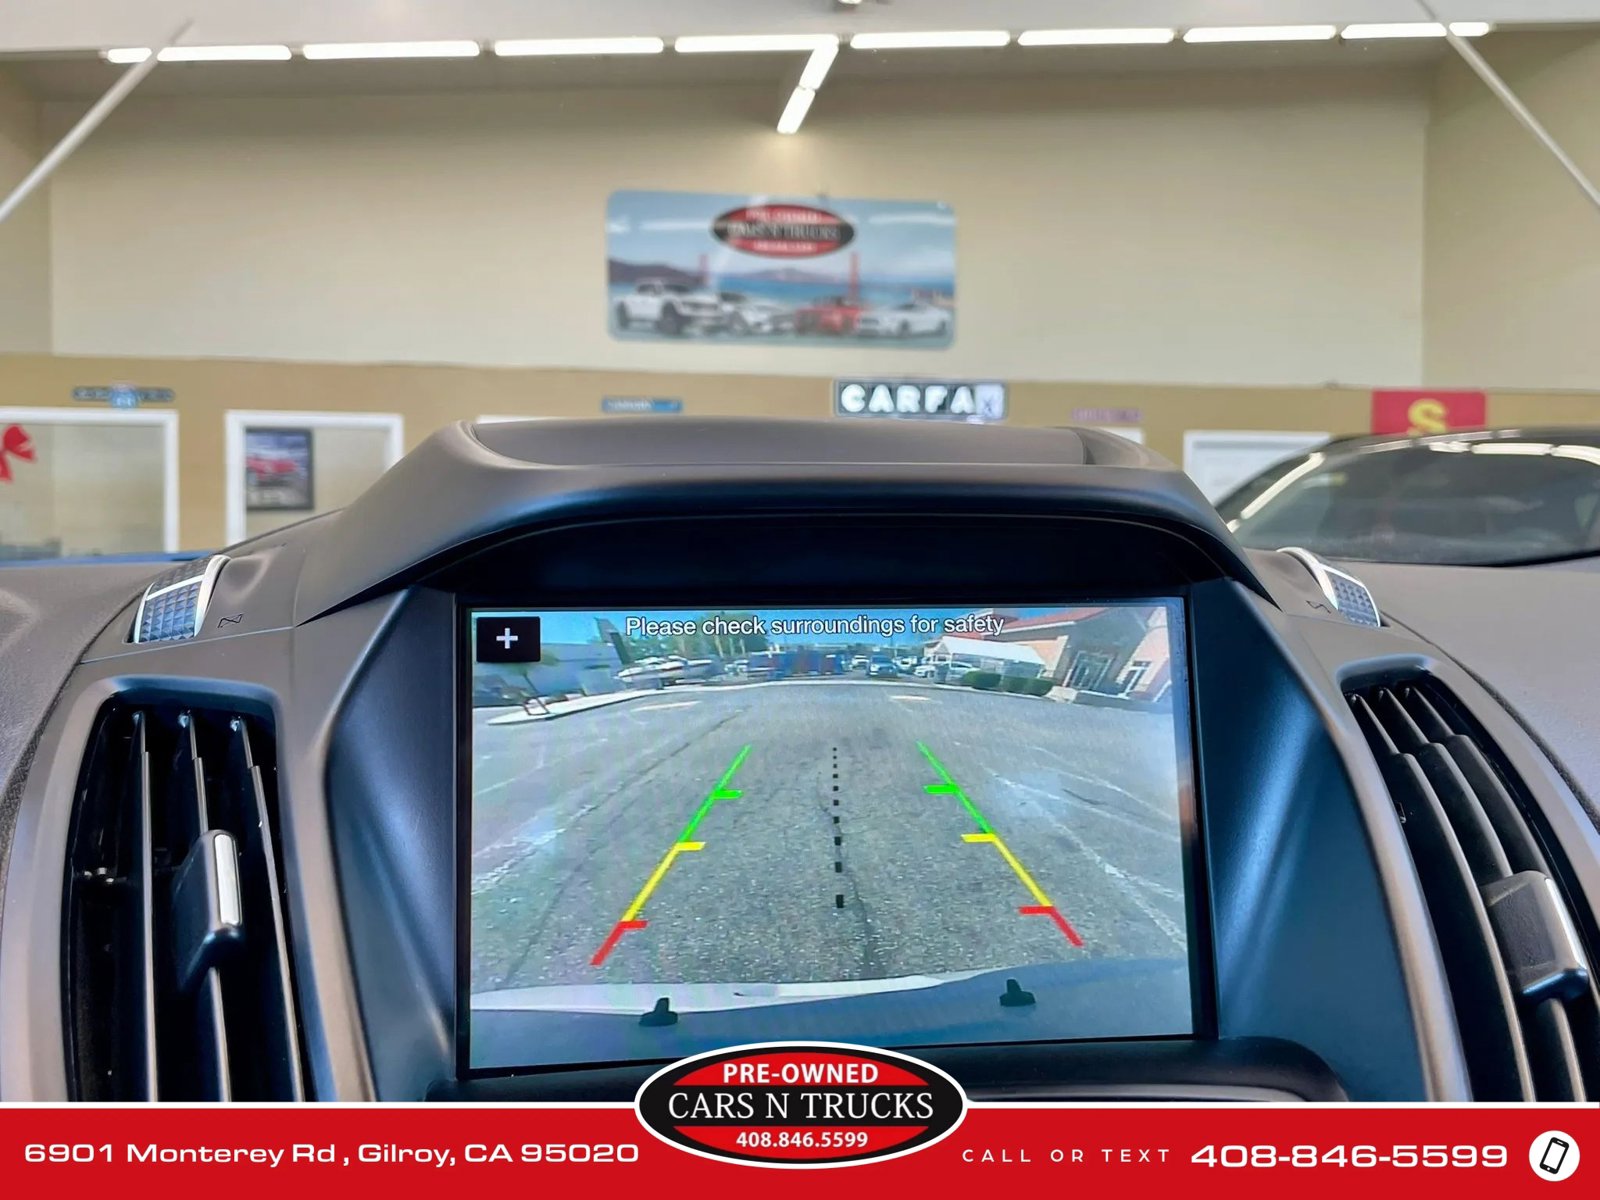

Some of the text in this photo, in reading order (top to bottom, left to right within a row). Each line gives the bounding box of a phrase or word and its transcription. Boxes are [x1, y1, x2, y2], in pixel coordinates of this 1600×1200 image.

[626, 614, 1004, 637] Please check surroundings for safety
